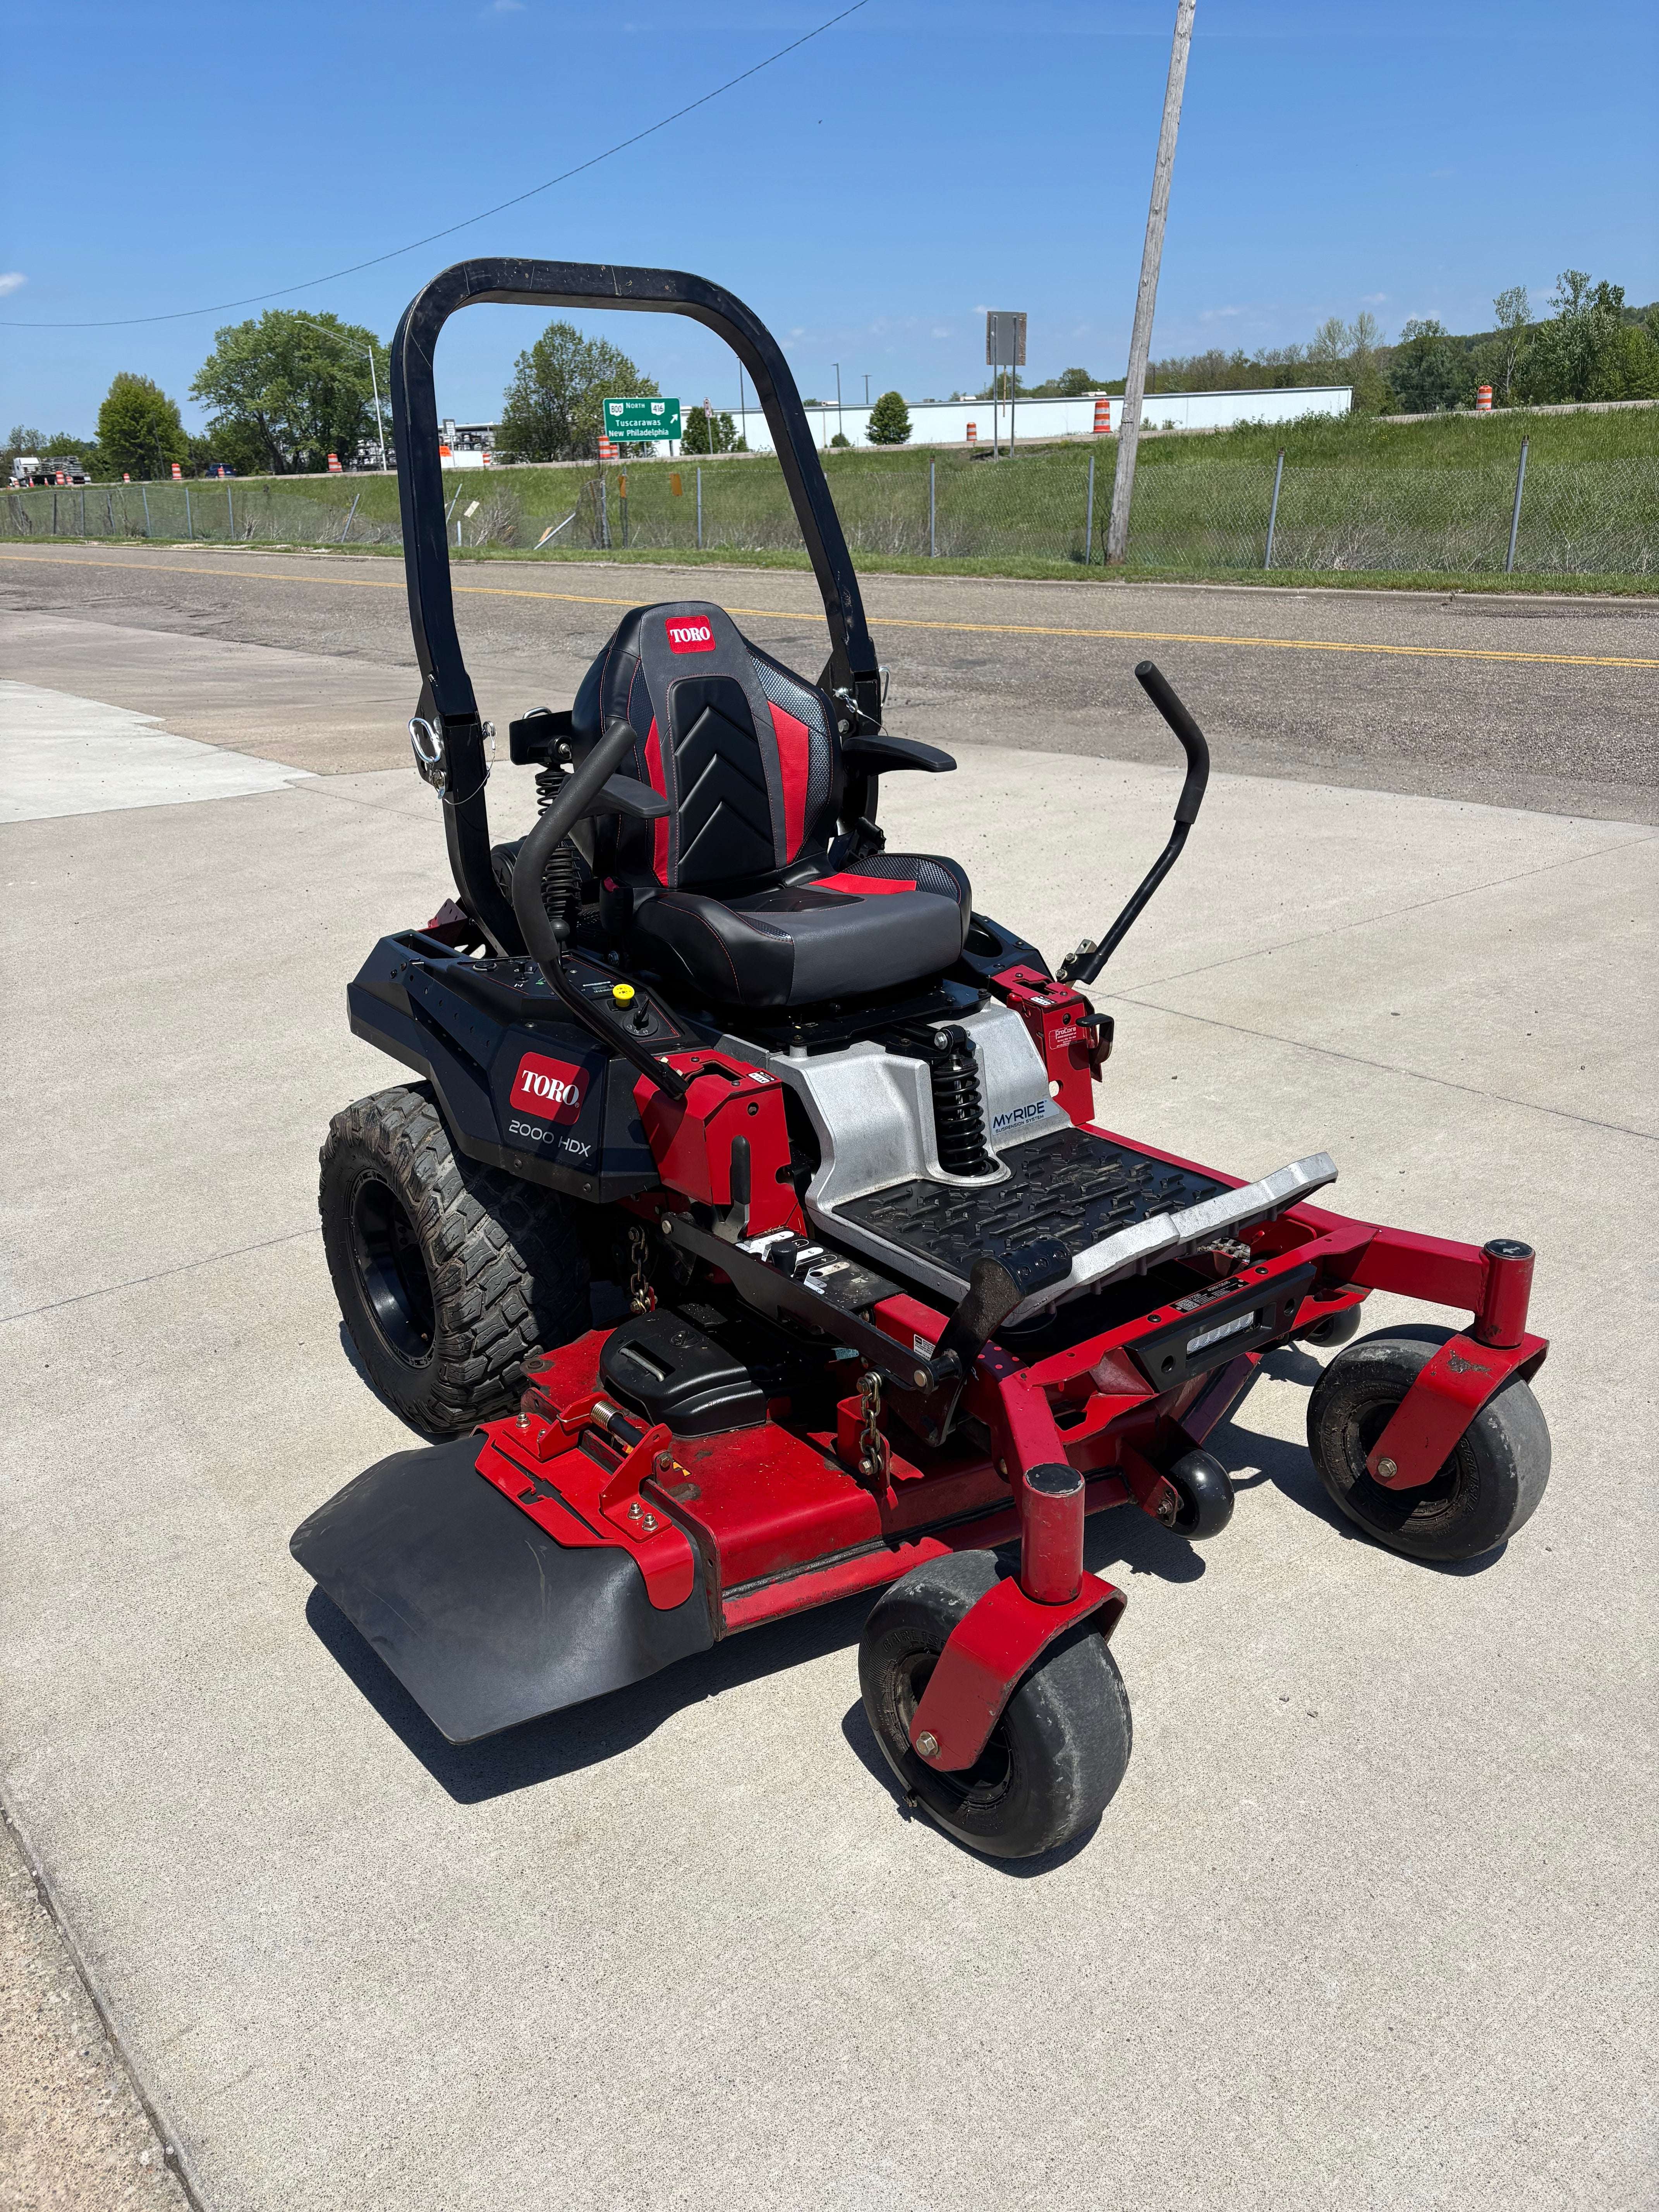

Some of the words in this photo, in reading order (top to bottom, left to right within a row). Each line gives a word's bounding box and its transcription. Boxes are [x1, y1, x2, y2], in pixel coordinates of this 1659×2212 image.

[626, 428, 669, 437] Philadelphia
[670, 627, 711, 643] TORO
[521, 1070, 579, 1105] TORO
[995, 1121, 1025, 1134] SUSPENSION
[1025, 1114, 1044, 1124] SYSTEM
[508, 1120, 555, 1144] 2000
[558, 1136, 592, 1157] HDX
